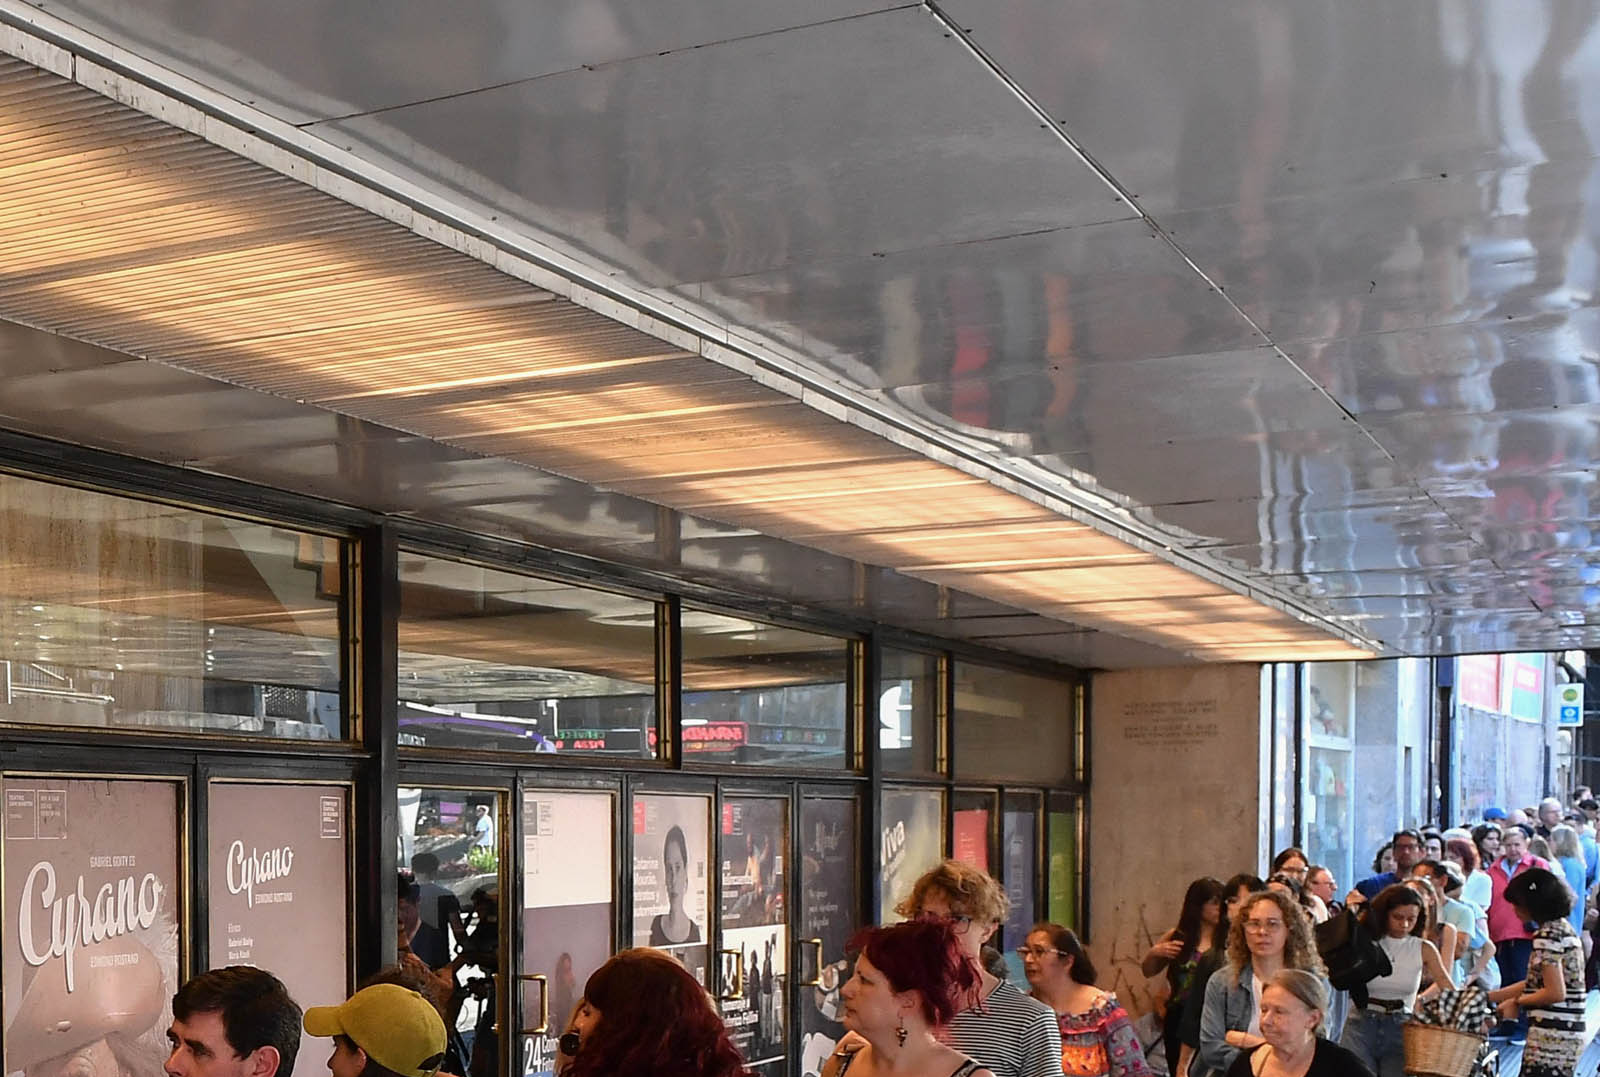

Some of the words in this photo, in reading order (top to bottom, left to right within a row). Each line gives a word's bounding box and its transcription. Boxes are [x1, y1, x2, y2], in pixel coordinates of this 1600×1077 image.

[226, 840, 294, 908] Cyrano
[19, 861, 164, 993] Cyrano
[525, 1037, 541, 1075] 24
